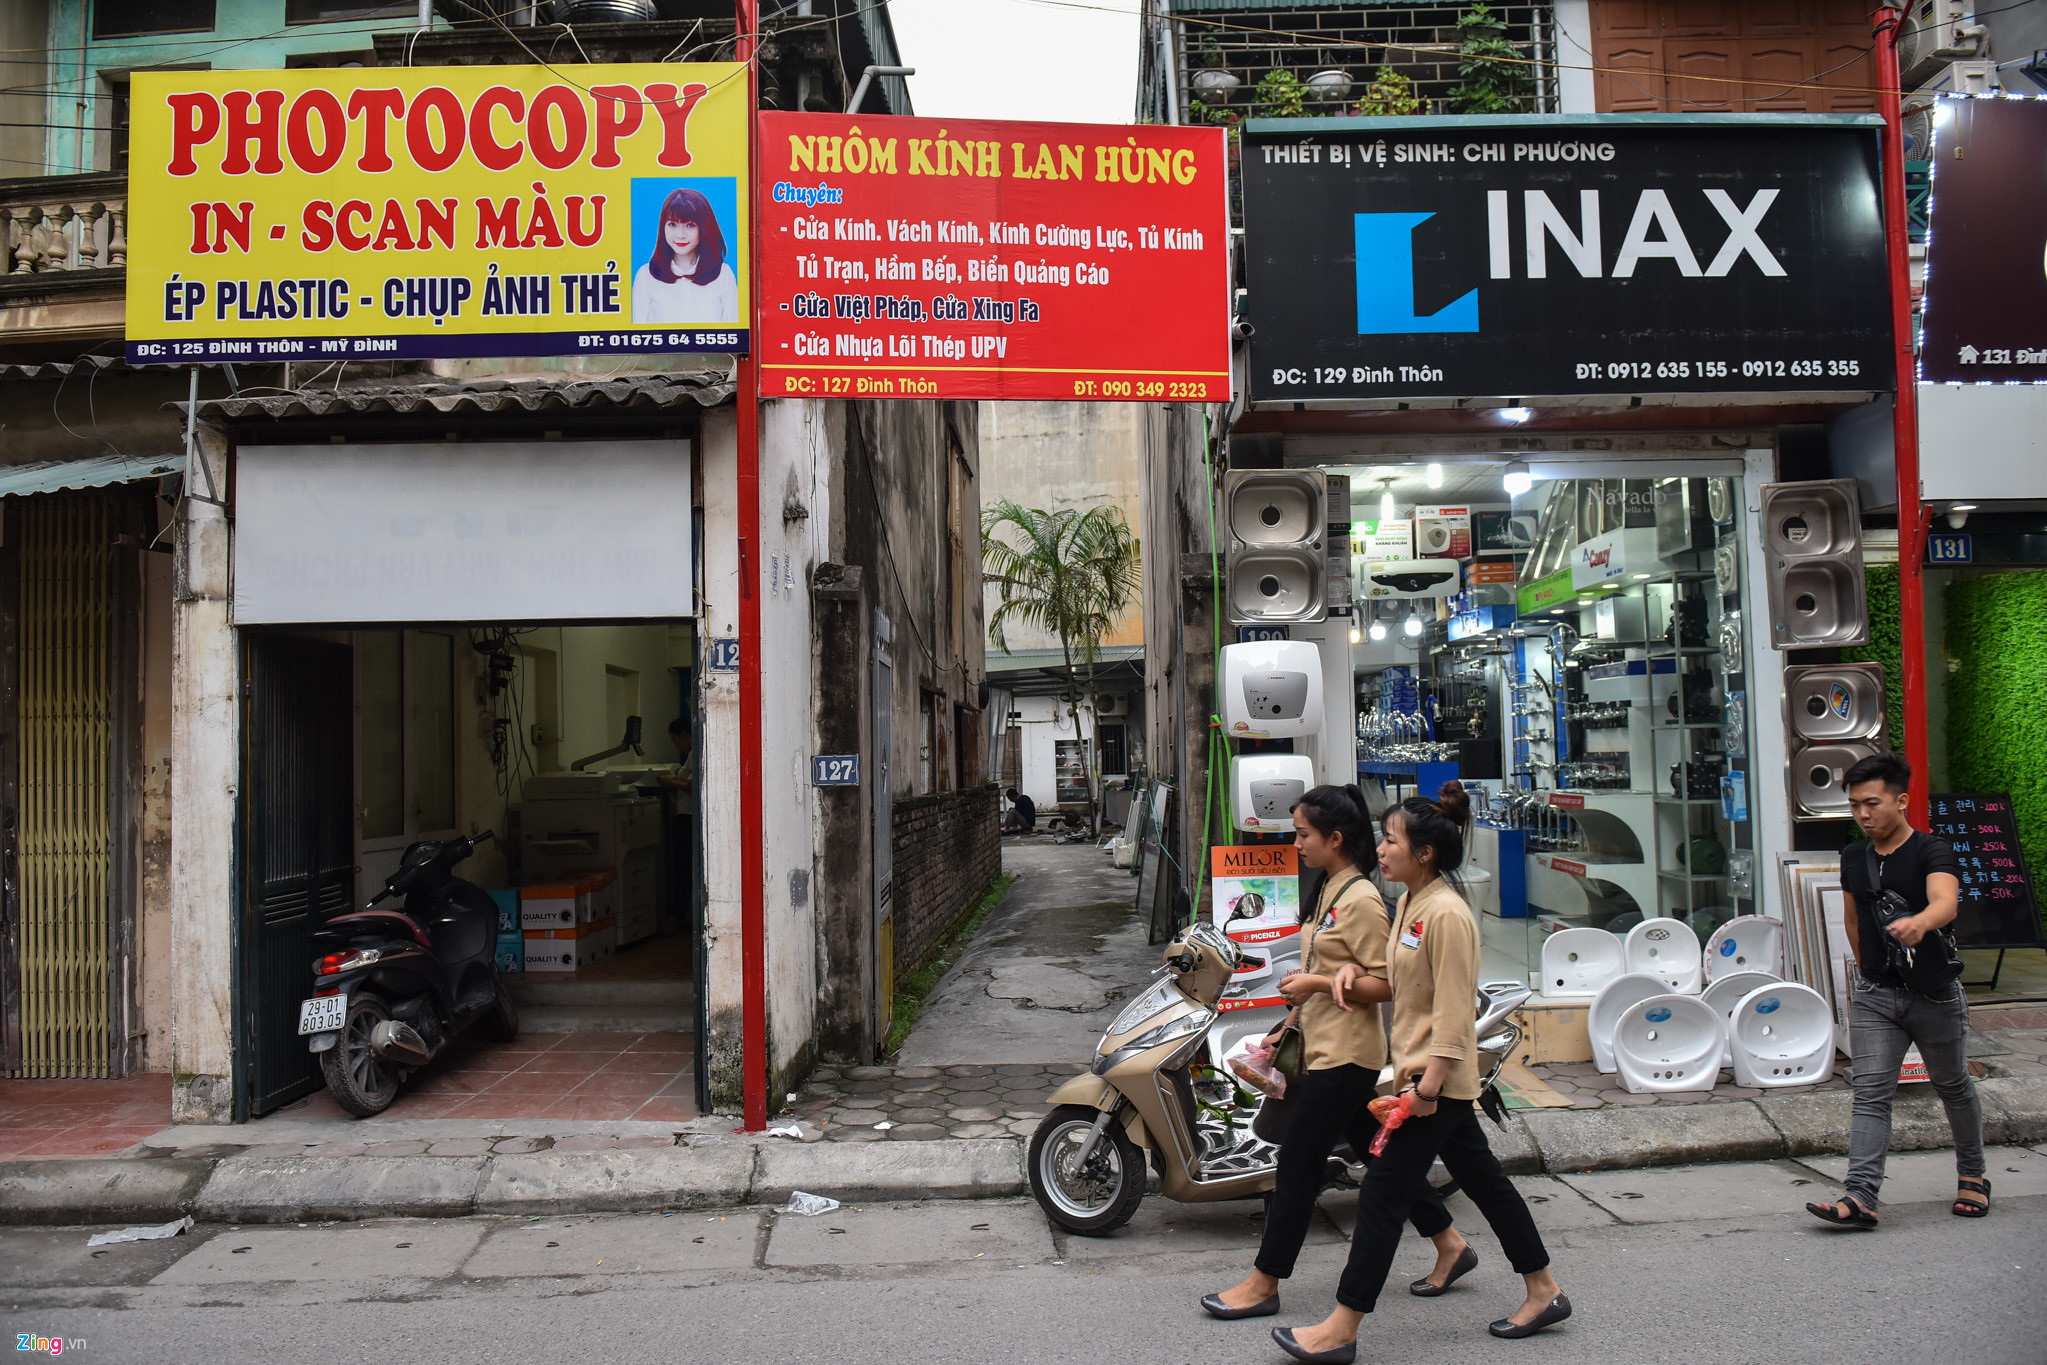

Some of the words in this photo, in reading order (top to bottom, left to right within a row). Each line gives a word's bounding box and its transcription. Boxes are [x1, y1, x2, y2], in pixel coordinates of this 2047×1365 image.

[165, 83, 708, 176] PHOTOCOPY
[789, 125, 898, 175] NHÔM
[909, 129, 1001, 178] KÍNH
[1012, 141, 1084, 181] LAN
[1095, 137, 1197, 185] HÙNG
[1261, 136, 1321, 164] THIẾT
[1329, 145, 1351, 169] BỊ
[1359, 139, 1386, 168] VỆ
[1394, 144, 1456, 163] SINH:
[1463, 144, 1506, 162] CHI
[1513, 141, 1616, 162] PHƯƠNG
[773, 181, 843, 208] Chuyên:
[189, 200, 255, 255] IN
[301, 197, 458, 252] SCAN
[476, 181, 606, 249] MÀU
[793, 216, 829, 241] Cửa
[887, 220, 933, 243] Vách
[938, 220, 984, 247] Kính,
[989, 222, 1030, 245] Kính
[1036, 223, 1091, 251] Cường
[1097, 226, 1133, 251] Lực,
[1138, 223, 1159, 248] Tủ
[1164, 227, 1204, 251] Kính
[1487, 188, 1787, 279] INAX
[797, 253, 818, 278] Tủ
[824, 256, 869, 282] Trạn,
[875, 254, 916, 281] Hầm
[922, 258, 962, 285] Bếp,
[967, 255, 1009, 282] Biển
[1014, 261, 1069, 287] Quảng
[1075, 262, 1109, 285] Cáo
[164, 274, 205, 322] ÉP
[216, 278, 350, 321] PLASTIC
[383, 275, 471, 327] CHỤP
[483, 261, 550, 316] ẢNH
[560, 259, 621, 314] THẺ
[794, 293, 830, 318] Cửa
[835, 295, 870, 324] Việt
[875, 296, 927, 324] Pháp,
[932, 295, 968, 320] Cửa
[973, 297, 1015, 324] Xing
[1019, 298, 1039, 322] Fa
[137, 343, 166, 357] ĐC:
[172, 342, 204, 356] 125
[208, 338, 252, 355] ĐÌNH
[257, 338, 304, 355] THÔN
[321, 338, 350, 353] MỸ
[354, 336, 398, 352] ĐÌNH
[578, 334, 604, 348] ĐT:
[609, 333, 663, 347] 01675
[669, 333, 689, 347] 64
[693, 332, 738, 346] 5555
[794, 329, 829, 357] Cửa
[836, 333, 883, 361] Nhựa
[889, 334, 916, 357] Lõi
[922, 336, 965, 363] Thép
[971, 337, 1007, 359] UPV
[1982, 349, 2012, 364] 131
[1272, 368, 1306, 386] ĐC:
[1312, 368, 1346, 384] 129
[1352, 365, 1394, 384] Đình
[1399, 365, 1443, 383] Thôn
[1576, 363, 1602, 379] ĐT:
[1608, 363, 1651, 378] 0912
[1656, 362, 1690, 378] 635
[1696, 362, 1727, 378] 155
[1742, 361, 1786, 377] 0912
[1790, 361, 1823, 376] 635
[1828, 361, 1860, 376] 355
[785, 377, 816, 392] ĐC:
[821, 378, 850, 393] 127
[856, 376, 894, 393] Đình
[899, 377, 938, 393] Thôn
[1074, 381, 1098, 396] ĐT:
[1102, 381, 1131, 396] 090
[1136, 381, 1165, 397] 349
[1169, 382, 1206, 397] 2323
[1587, 487, 1667, 505] Navado
[1935, 538, 1966, 559] 131
[716, 644, 739, 666] 12
[819, 760, 852, 780] 127
[1251, 931, 1280, 940] PICENZA
[308, 998, 340, 1016] 29-D1
[303, 1013, 341, 1031] 803.05
